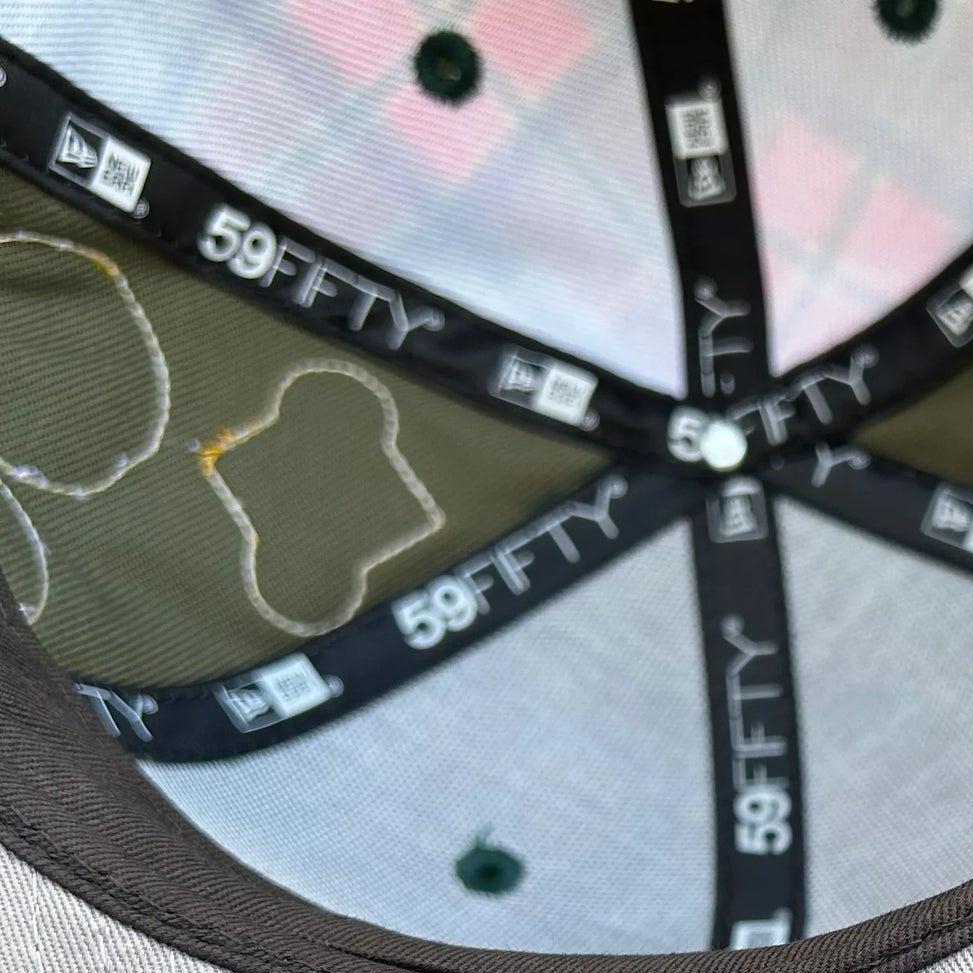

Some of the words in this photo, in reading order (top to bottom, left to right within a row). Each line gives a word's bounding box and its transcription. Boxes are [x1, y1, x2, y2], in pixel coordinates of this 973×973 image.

[198, 204, 435, 351] 59FIFTY
[391, 474, 621, 650] 59FIFTY
[723, 626, 793, 856] 59FIFTY
